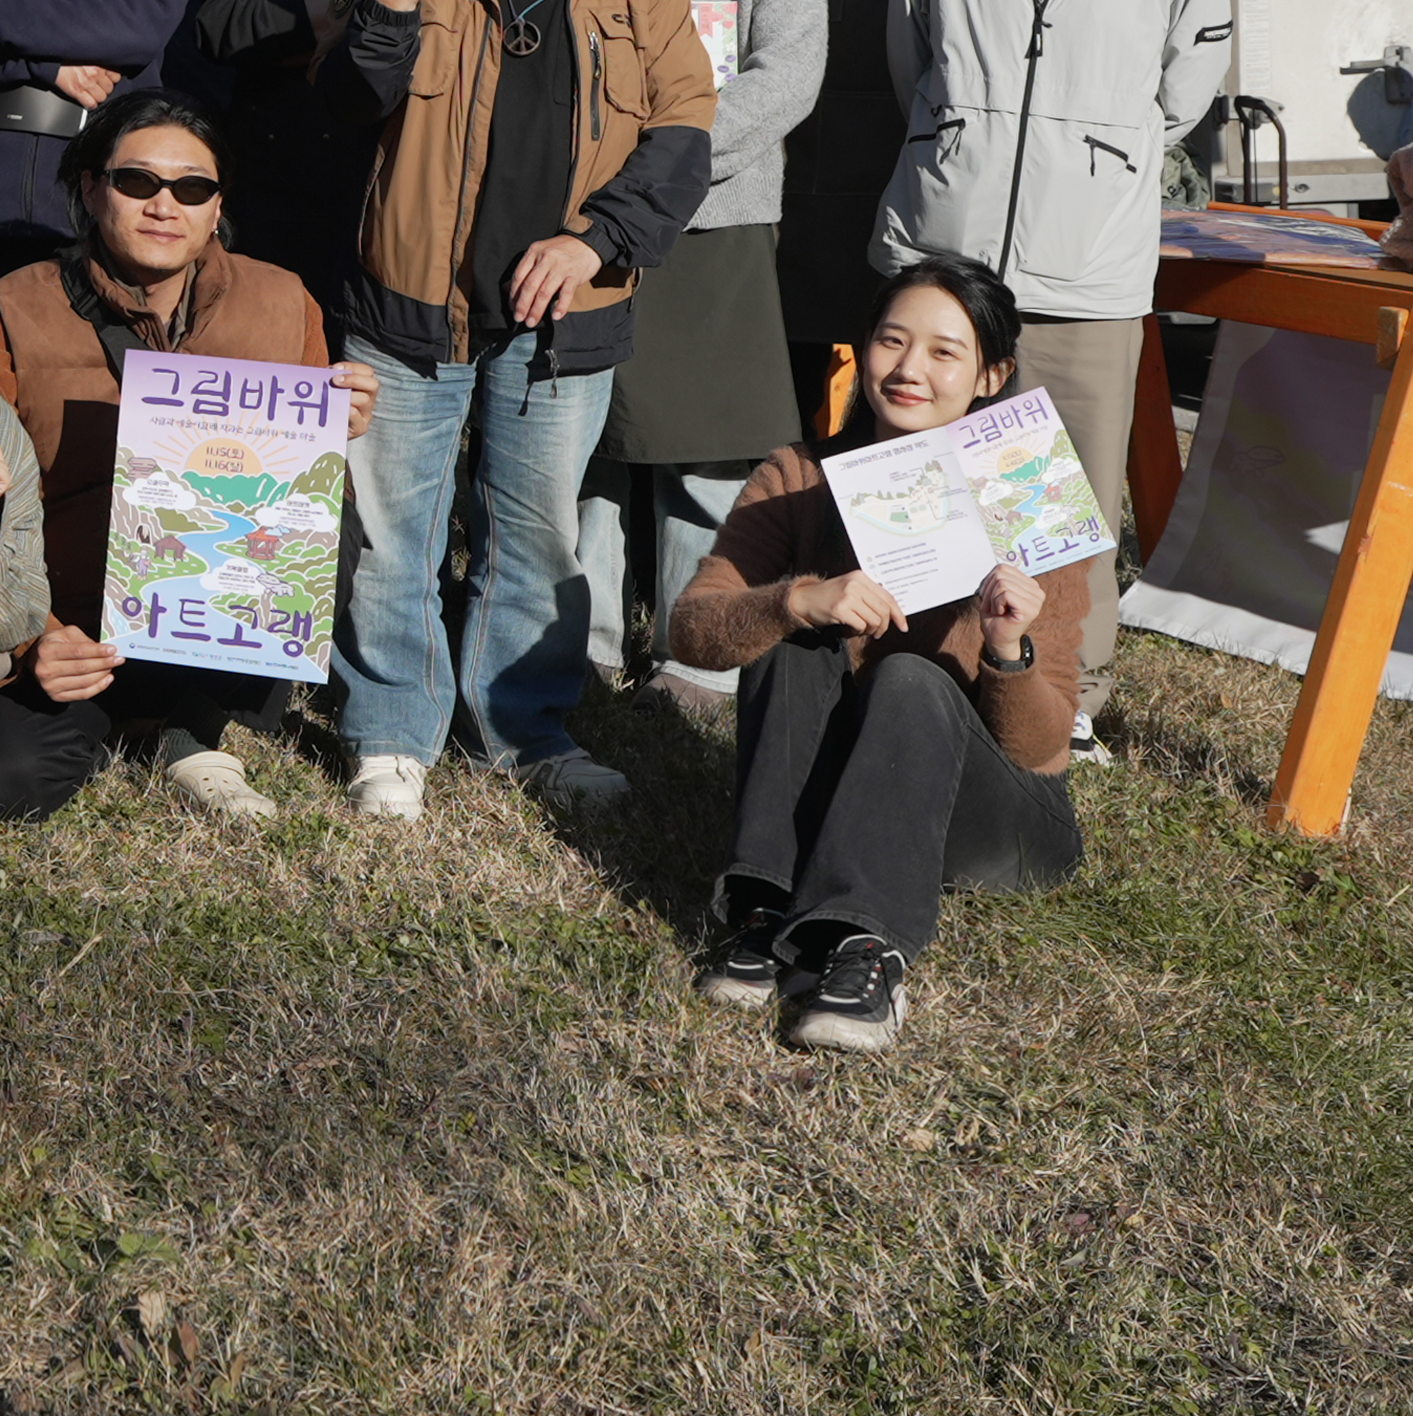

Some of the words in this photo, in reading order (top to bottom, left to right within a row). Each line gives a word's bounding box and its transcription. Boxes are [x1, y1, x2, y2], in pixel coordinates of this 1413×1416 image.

[141, 368, 329, 427] 그림바위
[959, 395, 1049, 450] 그림바위
[205, 459, 244, 473] 11.16(일)
[206, 446, 245, 460] 11.15(토)
[1005, 515, 1101, 568] 아트고랭
[122, 592, 312, 658] 아트고랭
